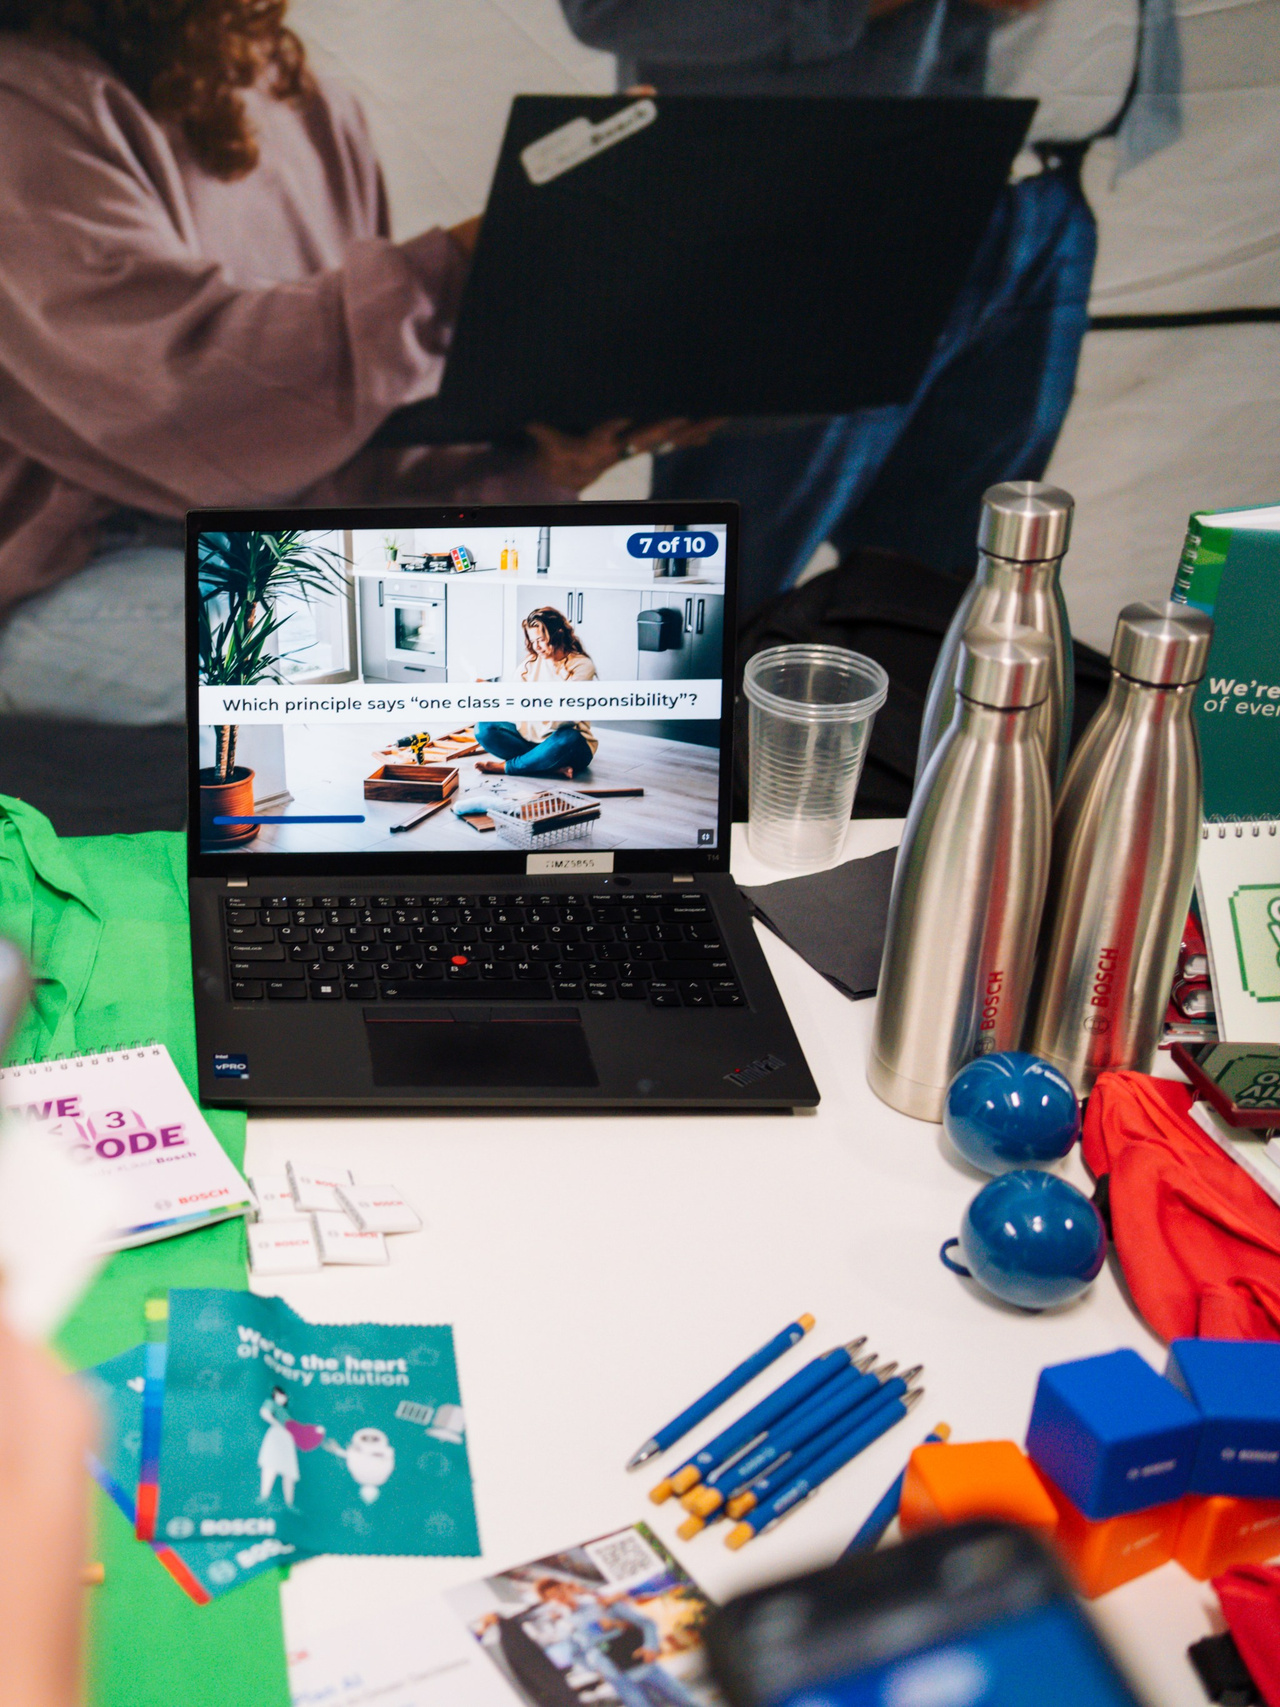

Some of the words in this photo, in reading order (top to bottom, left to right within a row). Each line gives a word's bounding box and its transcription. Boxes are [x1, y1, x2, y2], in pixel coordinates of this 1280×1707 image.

[639, 537, 653, 554] 7
[657, 536, 680, 553] of
[683, 536, 706, 553] 10
[223, 698, 278, 711] Which
[285, 697, 362, 713] principle
[368, 698, 405, 712] says
[457, 696, 500, 708] class
[520, 697, 553, 708] one
[1203, 696, 1230, 712] of
[1090, 948, 1119, 1008] BOSCH
[980, 970, 1004, 1031] BOSCH
[7, 1097, 81, 1122] WE
[105, 1111, 126, 1129] 3
[67, 1125, 186, 1165] CODE
[178, 1188, 230, 1206] BOSCH
[274, 1239, 309, 1248] BOSCH
[300, 1354, 339, 1371] the
[345, 1355, 407, 1373] heart
[320, 1369, 410, 1387] solution
